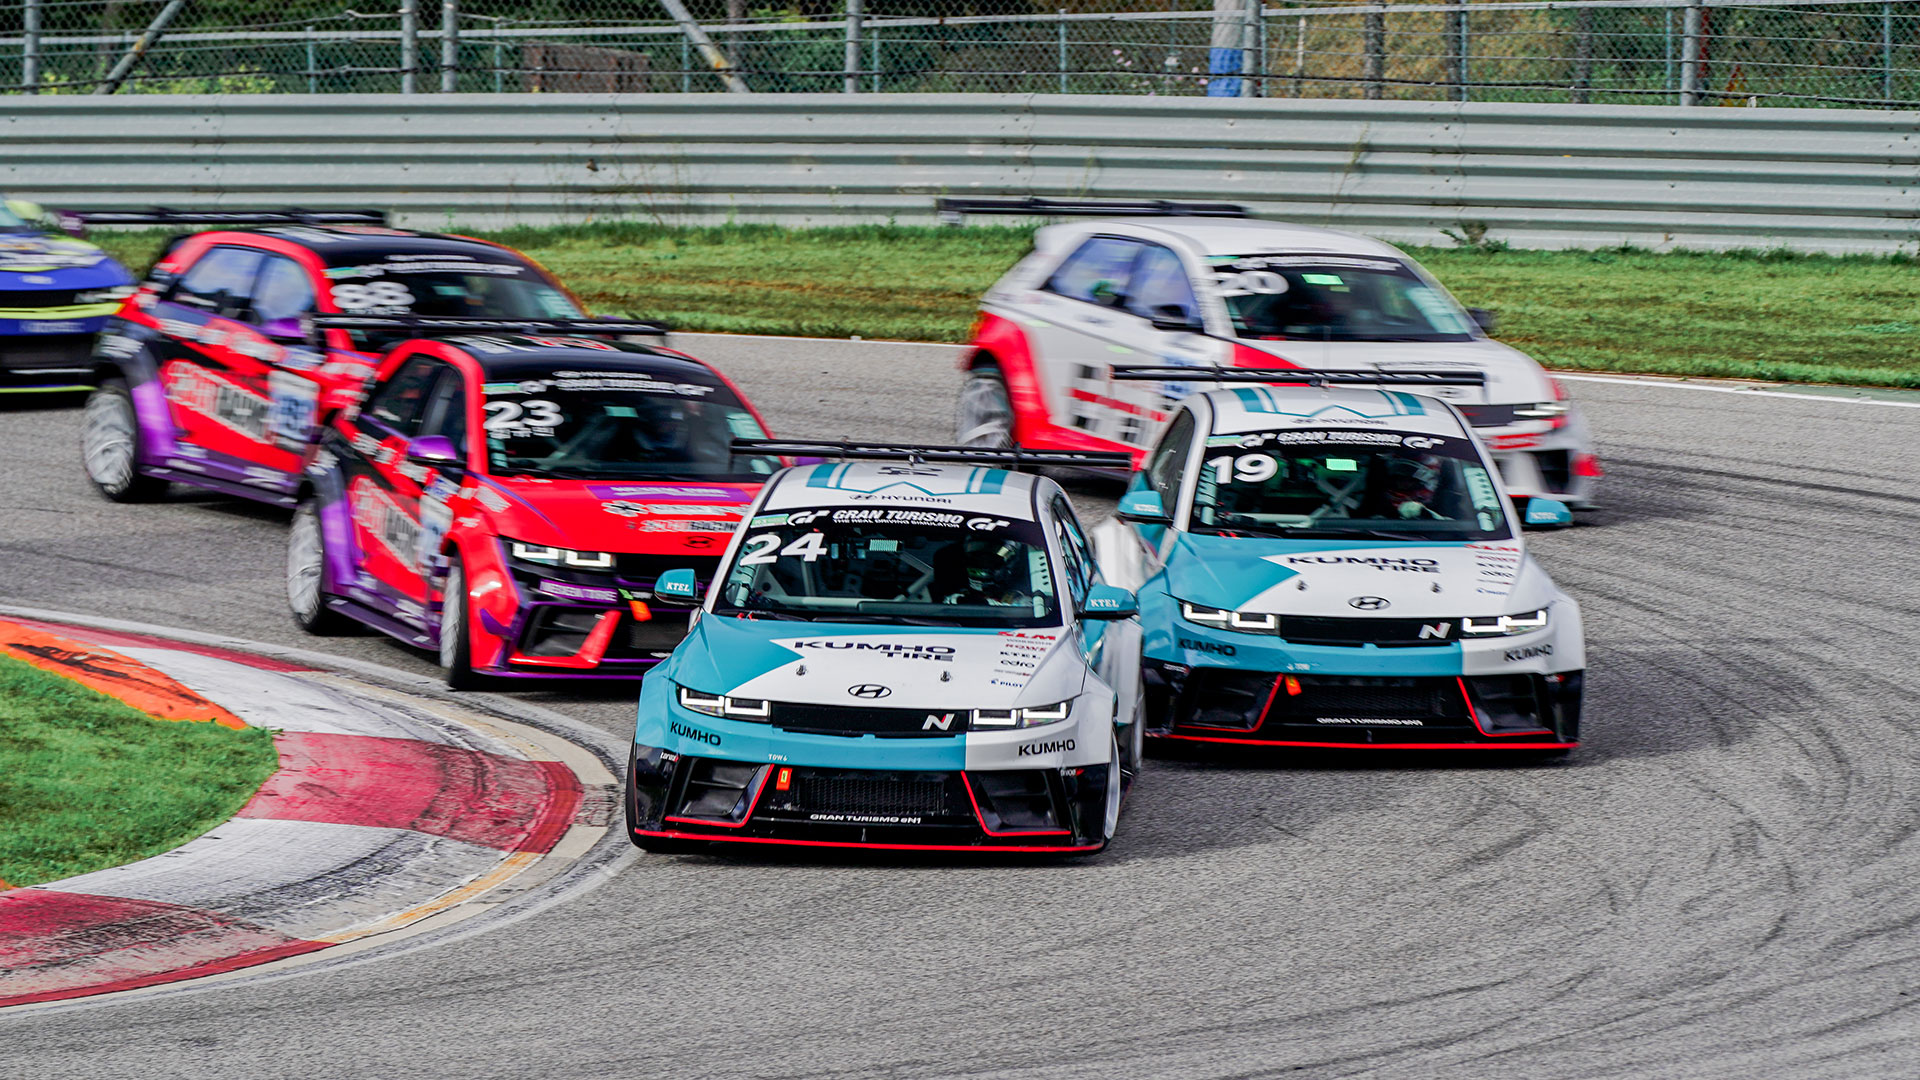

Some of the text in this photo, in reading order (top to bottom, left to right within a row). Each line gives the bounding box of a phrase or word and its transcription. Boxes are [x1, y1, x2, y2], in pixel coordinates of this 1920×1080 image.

[1203, 271, 1290, 297] 20
[330, 281, 416, 309] 88
[482, 400, 564, 429] 23
[1277, 431, 1326, 443] GRAN
[1327, 432, 1402, 444] TURISMO
[1207, 453, 1278, 484] 19
[881, 495, 952, 504] HYUNDAI
[832, 510, 965, 525] GRAN TURISMO
[911, 520, 960, 528] SIMULATOR
[740, 532, 828, 567] 24
[1287, 556, 1441, 566] KUMHO
[1369, 564, 1441, 573] TIRE
[666, 582, 690, 592] KTEL
[1090, 599, 1120, 608] KTEL
[997, 631, 1056, 640] KLM
[794, 641, 956, 654] KUMHO
[1178, 637, 1236, 656] KUMHO
[1503, 644, 1554, 662] KUMHO
[880, 651, 954, 662] TIRE
[1000, 651, 1041, 660] KTEL
[670, 721, 722, 746] KUMHO
[1018, 739, 1076, 757] KUMHO
[809, 813, 845, 821] GRAN
[845, 815, 900, 823] TURISMO
